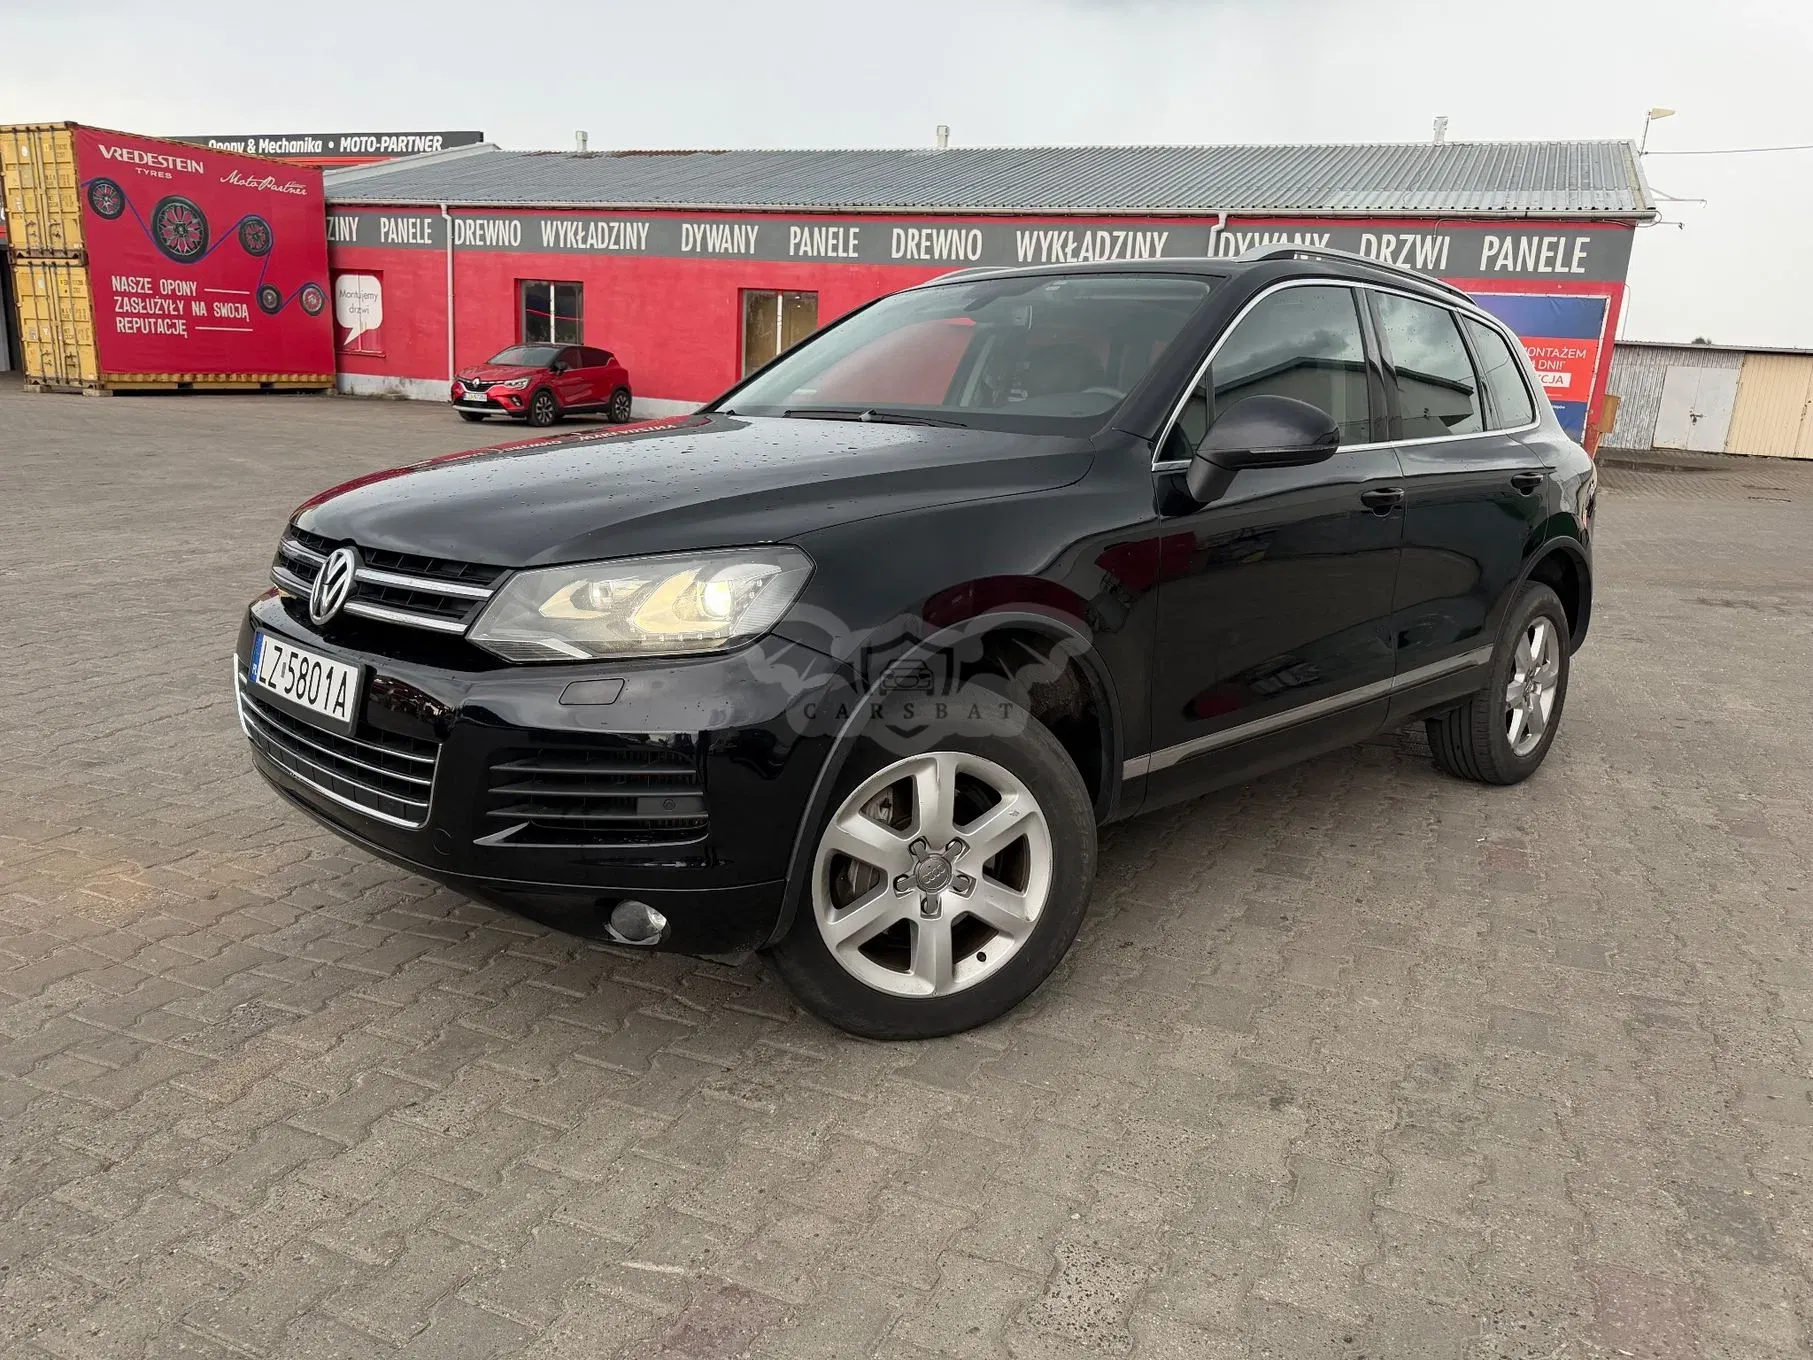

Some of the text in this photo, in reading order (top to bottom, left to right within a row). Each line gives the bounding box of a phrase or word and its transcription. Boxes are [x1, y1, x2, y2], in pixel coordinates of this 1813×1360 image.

[247, 139, 256, 154] &
[258, 137, 322, 153] Mechanika
[340, 136, 443, 152] MOTO-PARTNER
[98, 144, 204, 174] VREDESTEIN
[136, 167, 172, 179] TYRES
[380, 217, 432, 244] PANELE
[453, 218, 521, 247] DREWNO
[541, 220, 649, 250] WYKŁADZINY
[681, 223, 759, 254] DYWANY
[789, 226, 860, 258] PANELE
[891, 228, 983, 262] DREWNO
[1016, 230, 1169, 262] WYKŁADZINY
[1359, 233, 1450, 270] DRZWI
[1480, 235, 1590, 274] PANELE
[111, 275, 197, 297] NASZE OPONY
[113, 295, 250, 323] ZASŁUŻYŁY NA SWOJĄ
[116, 316, 188, 339] REPUTACJĘ
[1524, 346, 1587, 359] ONTAŻEM
[1538, 374, 1564, 385] CJA
